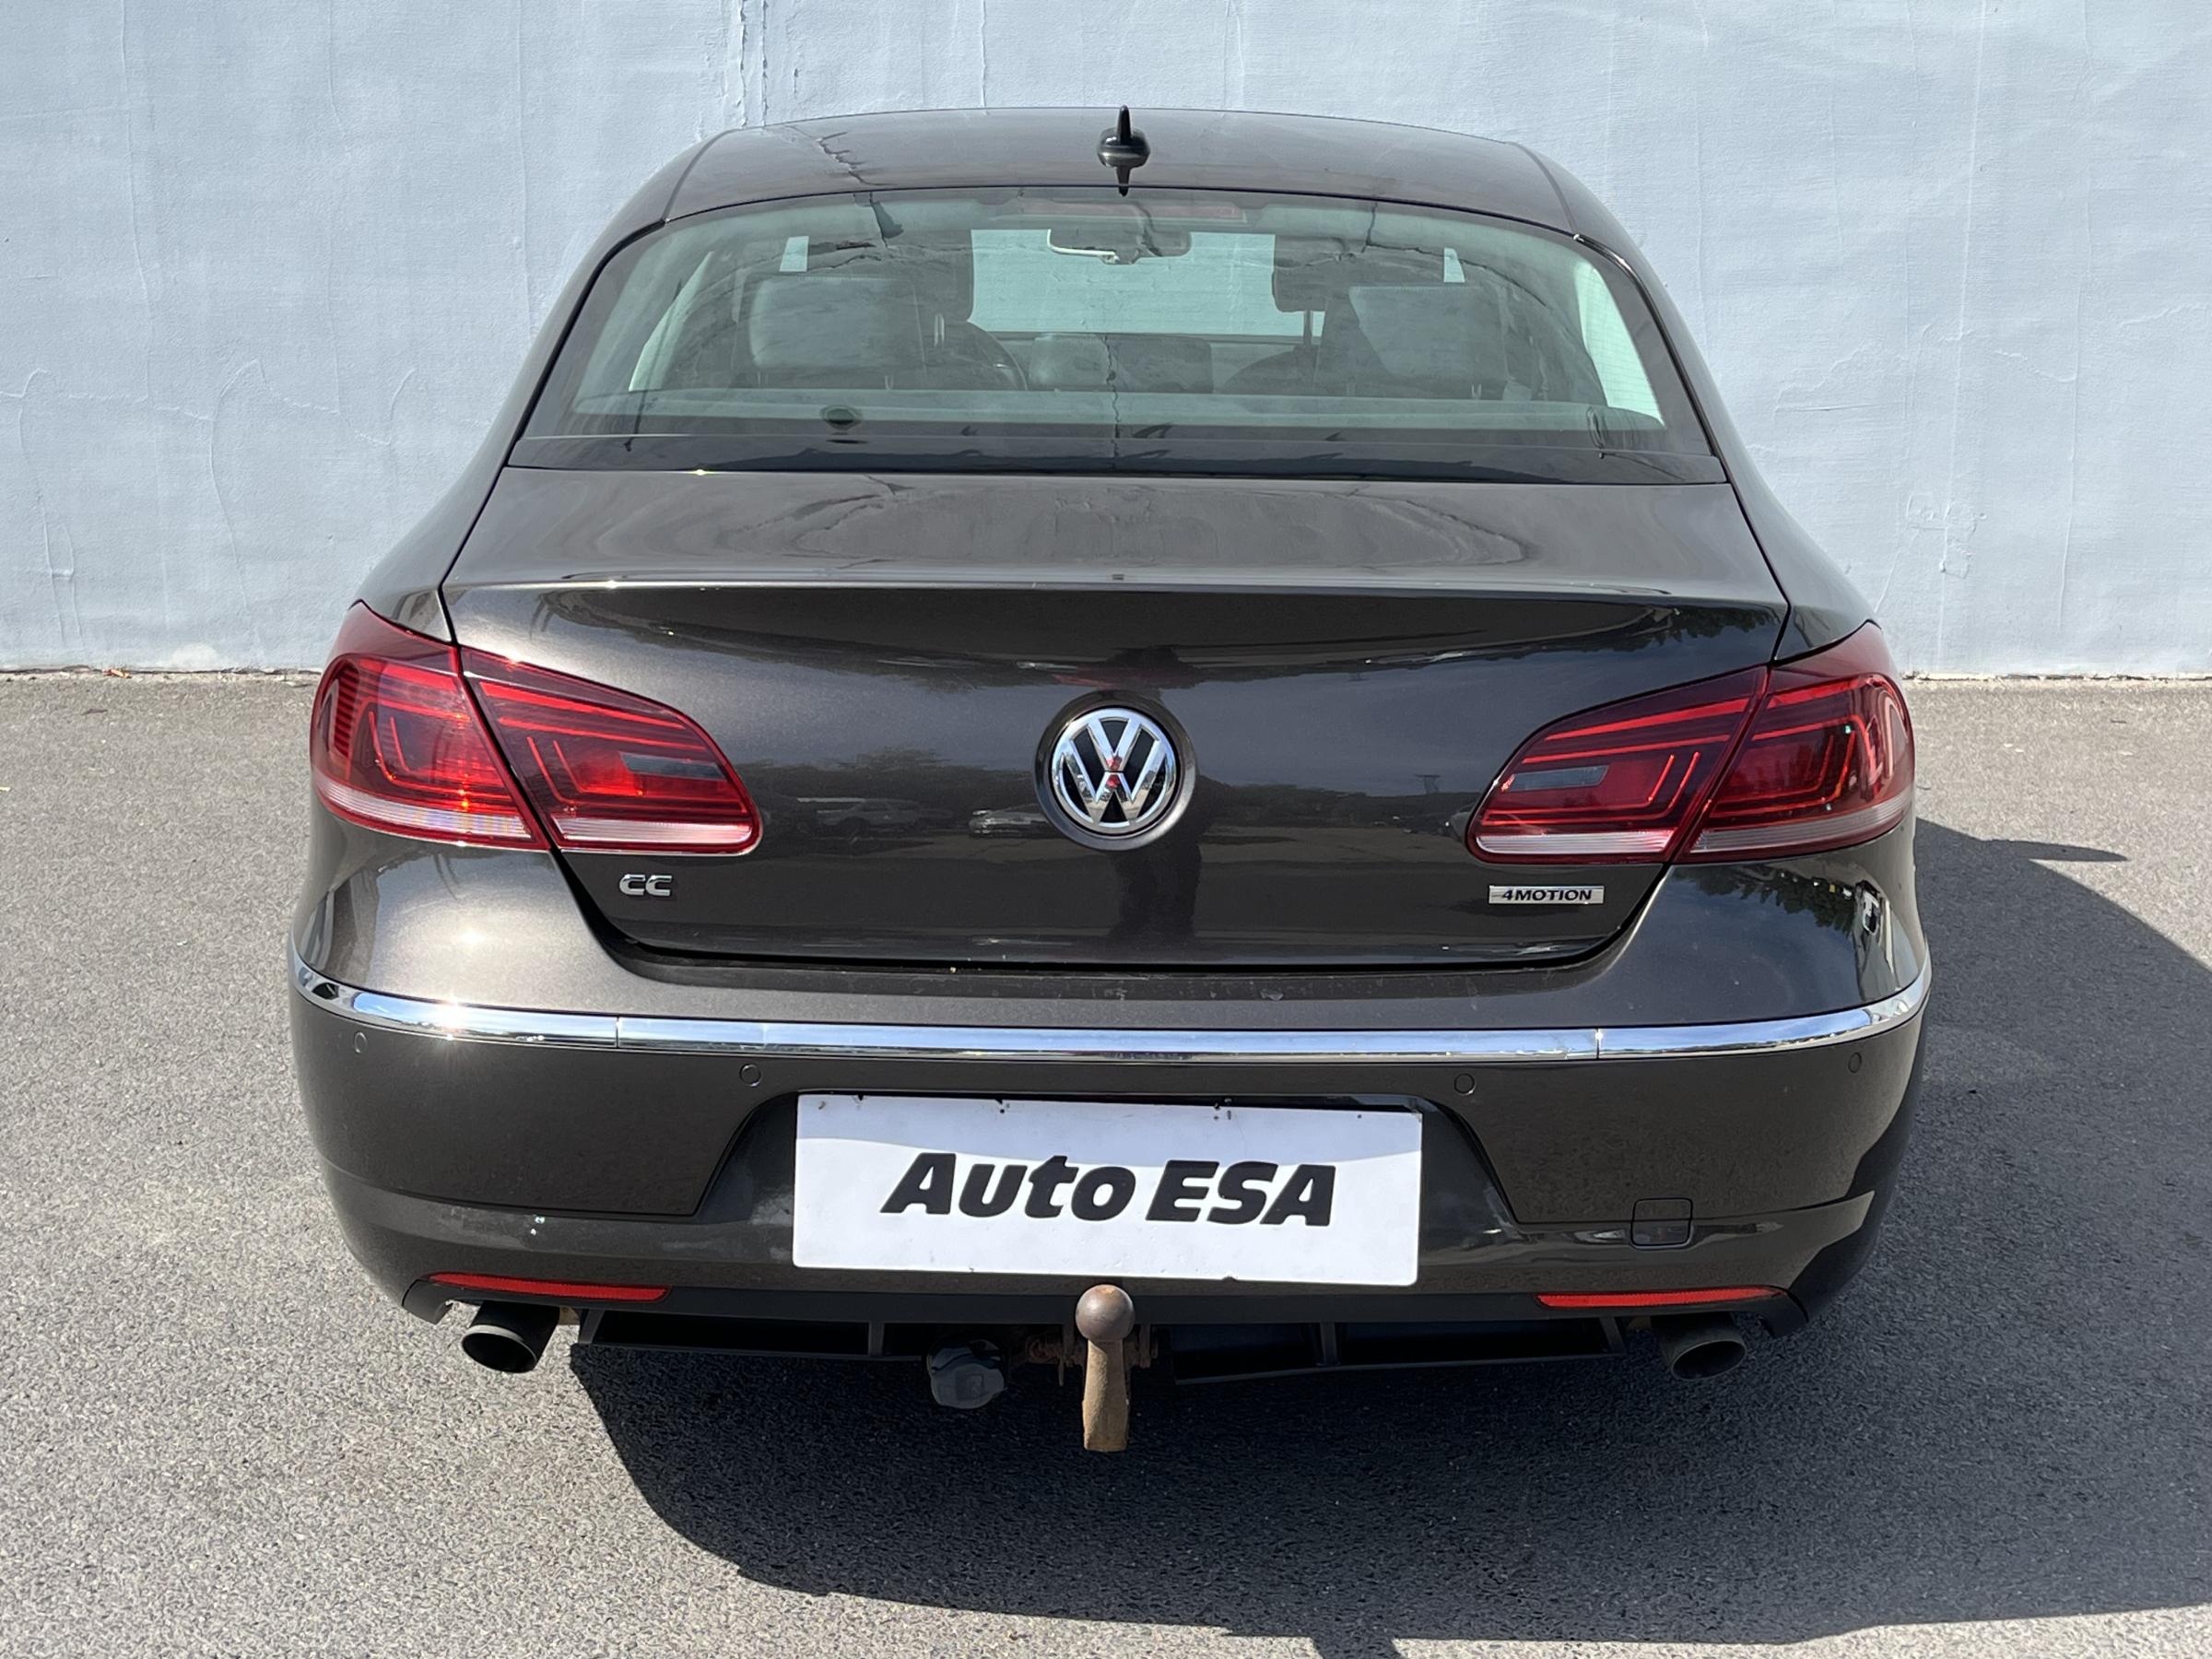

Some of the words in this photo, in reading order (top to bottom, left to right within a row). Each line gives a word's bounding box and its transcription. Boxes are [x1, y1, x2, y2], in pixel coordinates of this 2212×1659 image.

[618, 873, 673, 897] CC
[1501, 889, 1593, 901] 4MOTION
[879, 1151, 1136, 1222] Auto
[1145, 1159, 1337, 1228] ESA
